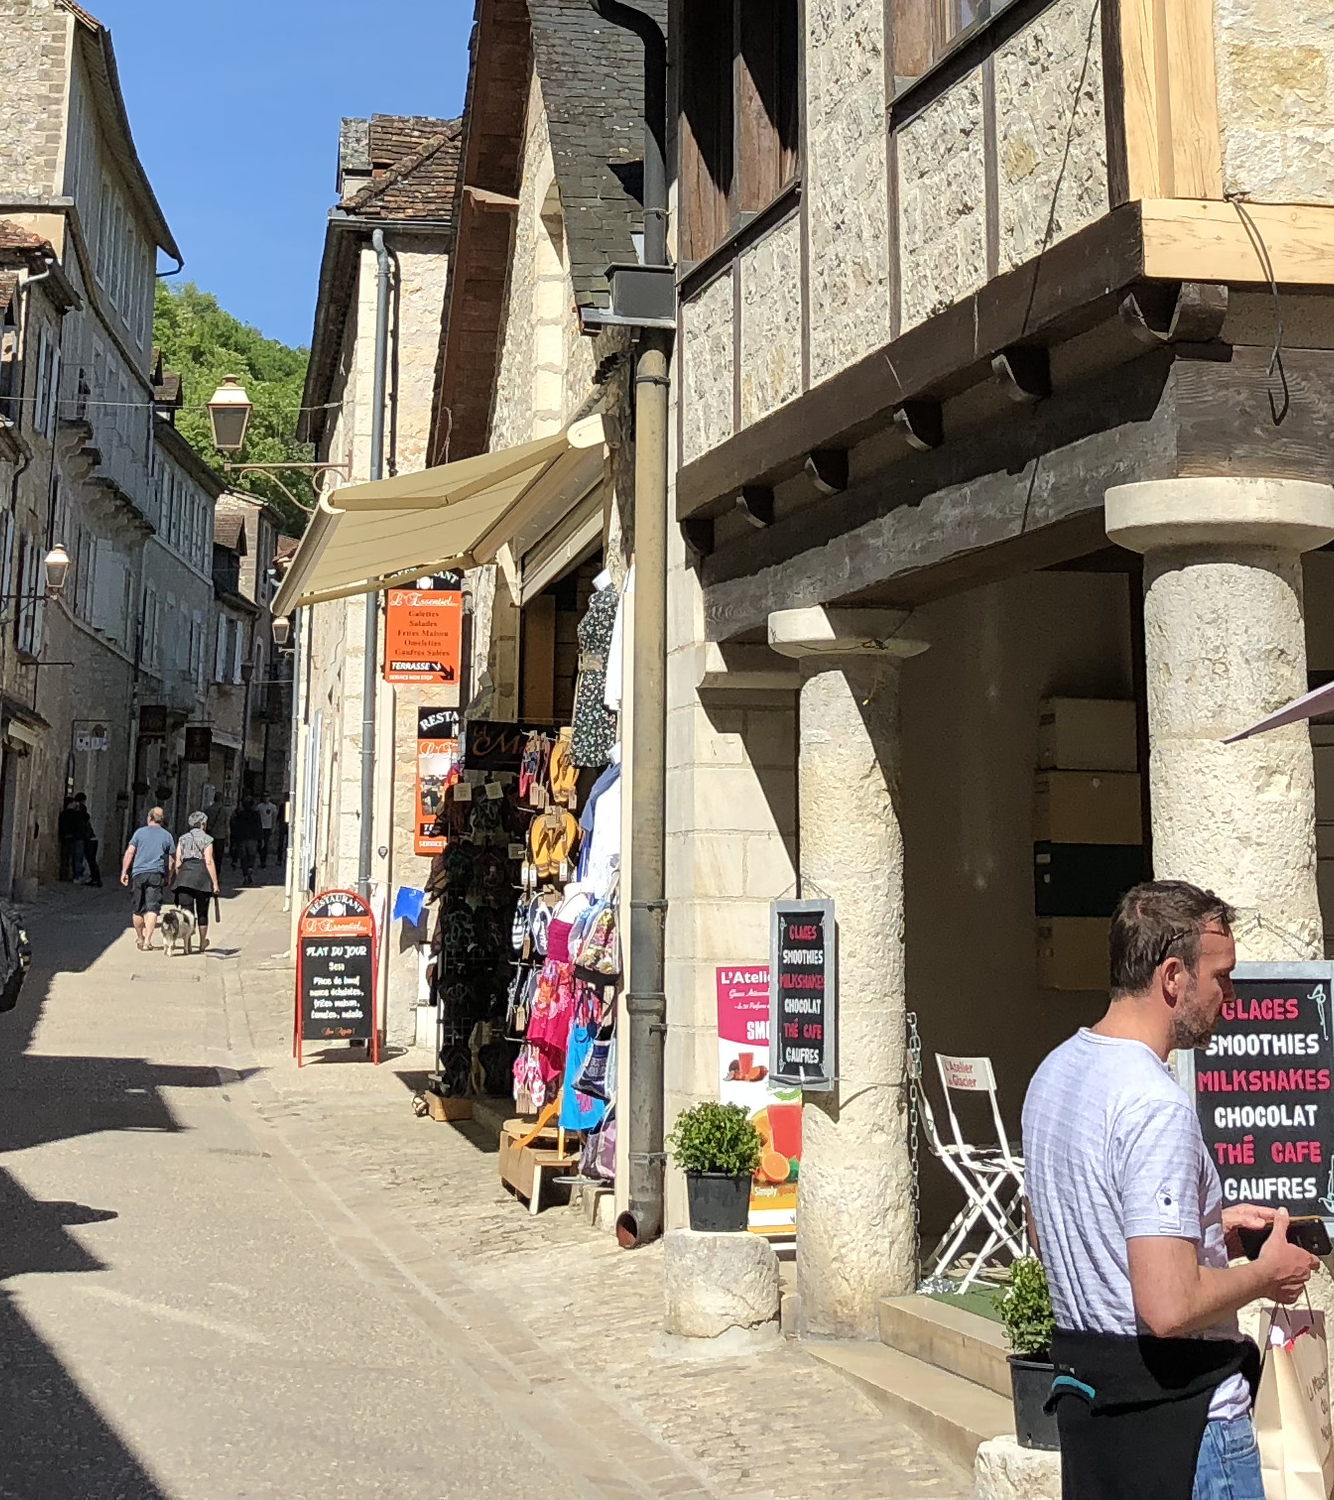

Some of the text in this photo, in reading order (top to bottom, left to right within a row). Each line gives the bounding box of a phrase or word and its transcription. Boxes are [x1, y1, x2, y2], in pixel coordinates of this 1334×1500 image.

[391, 662, 431, 670] TERRASSE
[309, 894, 365, 916] RESTAURANT
[789, 924, 817, 940] GLACES
[306, 946, 367, 959] PLAT DU JOUR
[782, 949, 824, 965] SMOOTHIES
[779, 973, 825, 990] MILKSHAKES
[784, 998, 822, 1014] CHOCOLAT
[1220, 998, 1300, 1021] GLACES
[783, 1018, 822, 1040] THÉ CAFE
[1204, 1033, 1320, 1056] SMOOTHIES
[785, 1047, 819, 1064] GAUFRES
[1197, 1068, 1332, 1093] MILKSHAKES
[1214, 1104, 1318, 1129] CHOCOLAT
[1214, 1134, 1323, 1166] THÉ CAFE
[755, 1186, 777, 1198] Simply
[1223, 1177, 1318, 1201] GAUFRES
